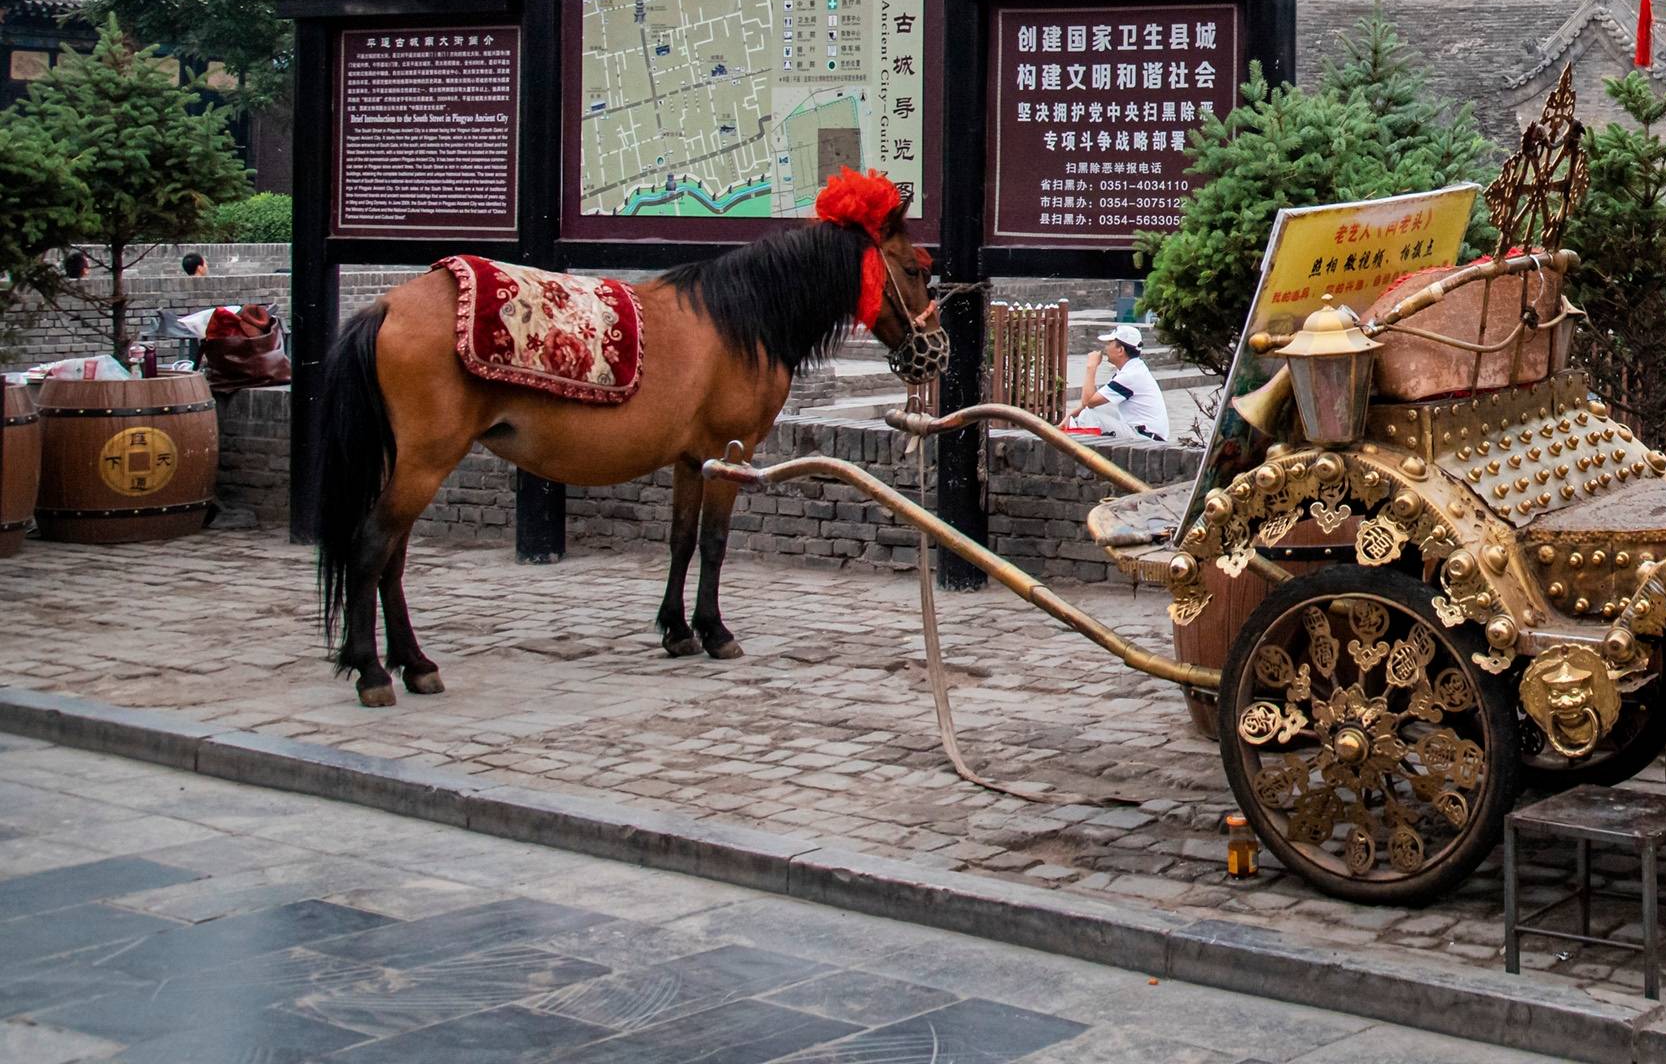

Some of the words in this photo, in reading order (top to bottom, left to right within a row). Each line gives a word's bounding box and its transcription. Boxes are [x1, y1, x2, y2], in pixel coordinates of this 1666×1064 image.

[880, 0, 891, 62] Ancient
[1017, 22, 1217, 53] 创建国家卫生县城
[1017, 61, 1216, 90] 构建文明和谐社会
[364, 114, 396, 123] Introduction
[403, 114, 412, 123] the
[413, 114, 428, 123] South
[429, 114, 445, 123] Street
[452, 114, 473, 124] Pingyao
[475, 113, 496, 123] Ancient
[497, 113, 509, 124] City
[1017, 101, 1214, 123] 坚决拥护党中央扫黑除恶
[1043, 130, 1186, 152] 专项斗争战略部署
[1065, 162, 1162, 174] 扫黑除恶举报电话
[105, 455, 122, 469] 下
[156, 452, 172, 466] 天
[1363, 527, 1394, 558] 福
